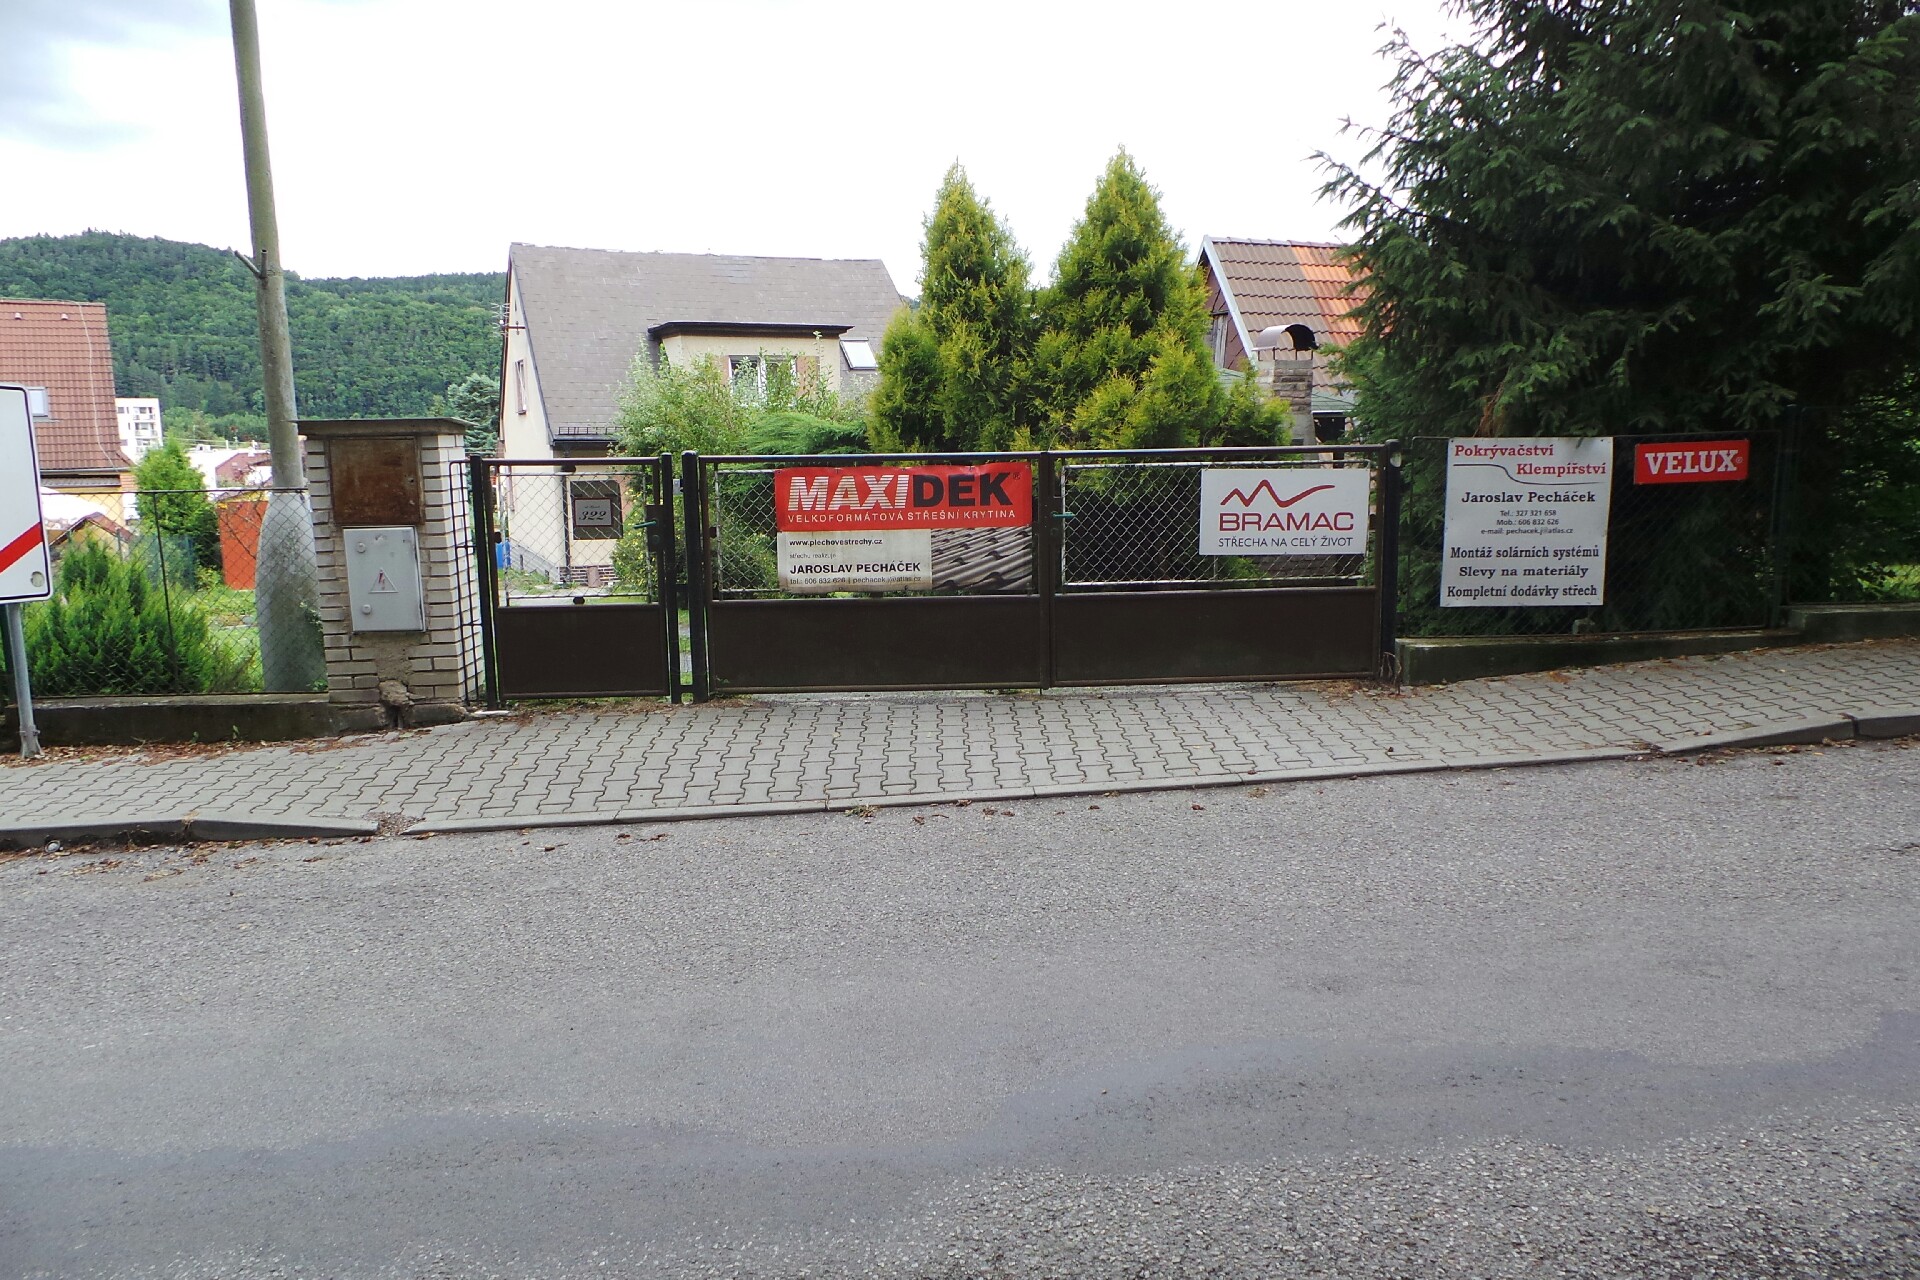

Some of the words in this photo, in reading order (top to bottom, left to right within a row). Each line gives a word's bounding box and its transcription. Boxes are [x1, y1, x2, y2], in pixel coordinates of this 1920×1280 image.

[1454, 444, 1554, 459] Pokrývačství
[1644, 449, 1739, 475] VELUX
[1516, 463, 1607, 477] Klempířství
[1461, 491, 1524, 503] Jaroslav
[1528, 491, 1596, 503] Pecháček
[579, 511, 607, 520] 322
[787, 510, 904, 523] VELKOFORMÁTOVÁ
[907, 509, 960, 521] STŘEŠNÍ
[963, 509, 1016, 519] KRYTINA
[1219, 512, 1354, 532] BRAMAC
[789, 538, 883, 547] www.plechovestrechy.cz
[1218, 535, 1268, 548] STŘECHA
[1271, 537, 1288, 547] NA
[1291, 535, 1317, 547] CELÝ
[1320, 535, 1354, 546] ŽIVOT
[1450, 546, 1492, 558] Montáž
[1496, 545, 1549, 558] solárních
[1552, 545, 1600, 560] systémů
[789, 564, 853, 574] JAROSLAV
[856, 561, 921, 573] PECHÁČEK
[1459, 566, 1496, 579] Slevy
[1501, 568, 1517, 577] na
[1523, 565, 1589, 578] materiály
[1447, 585, 1507, 600] Kompletní
[1510, 585, 1559, 599] dodávky
[1562, 585, 1598, 596] střech
